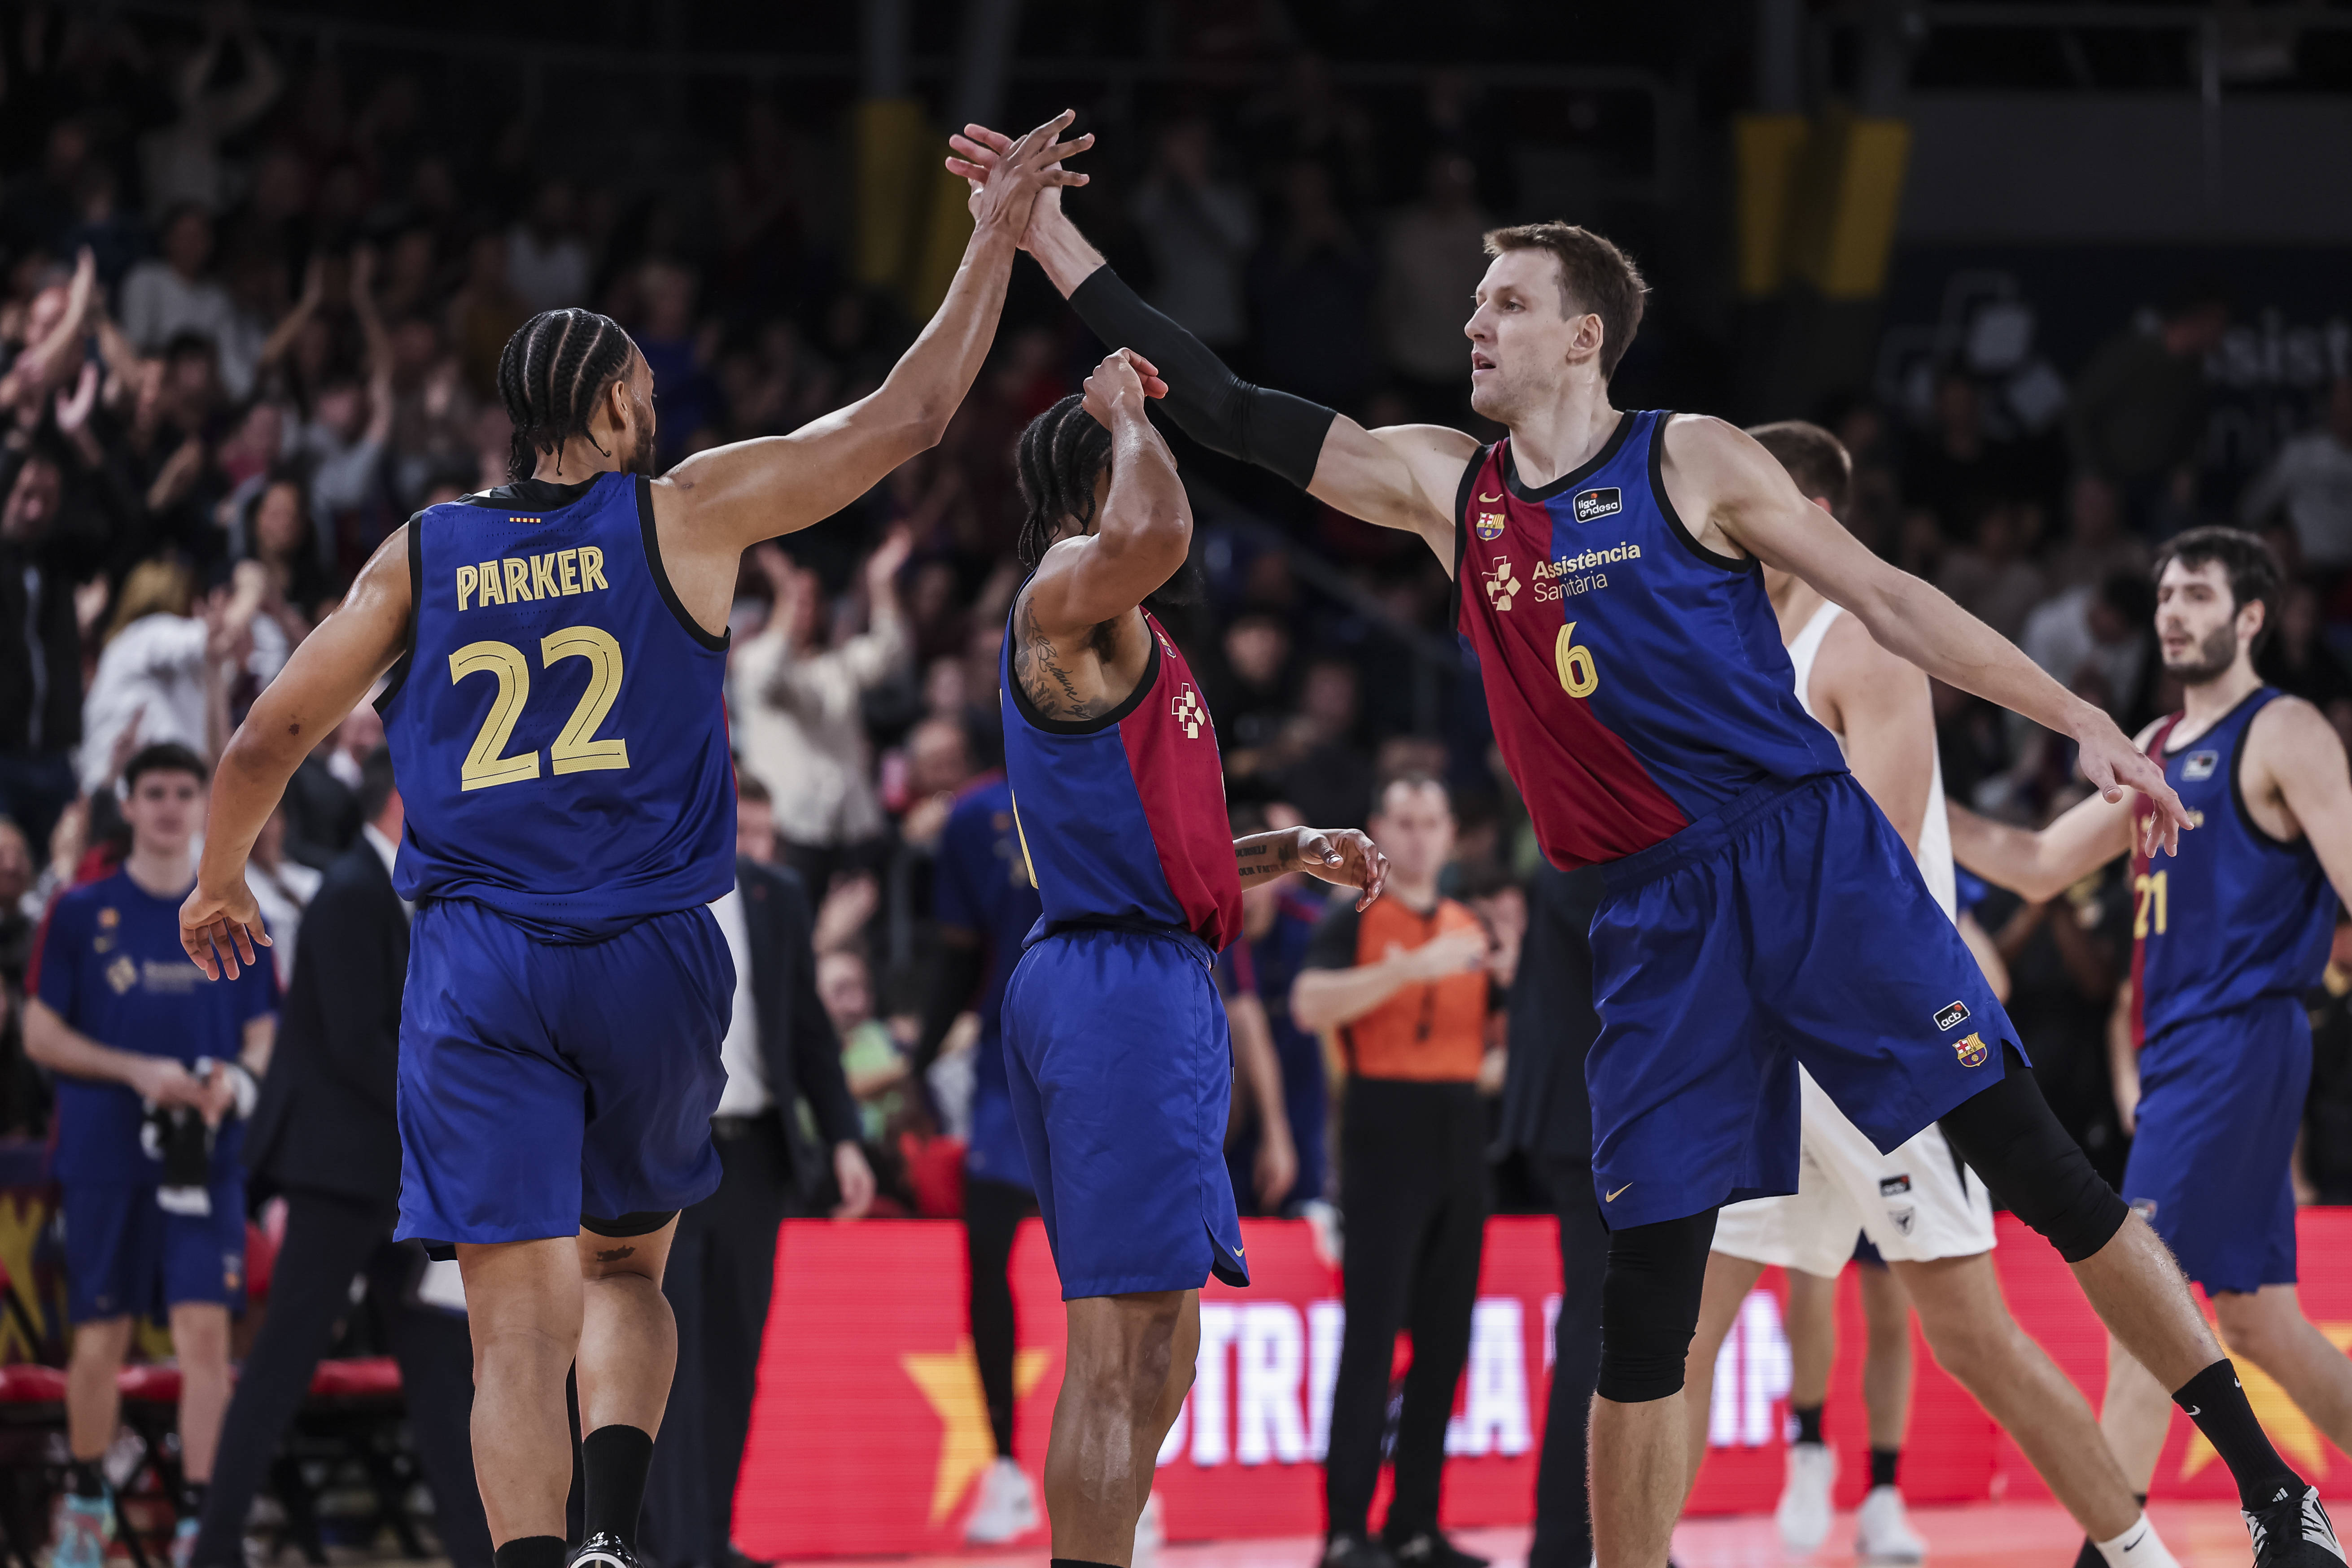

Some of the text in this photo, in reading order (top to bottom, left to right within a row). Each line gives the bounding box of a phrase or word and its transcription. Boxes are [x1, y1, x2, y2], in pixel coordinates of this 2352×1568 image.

[1578, 499, 1596, 509] liga
[1580, 502, 1618, 517] endesa
[1532, 541, 1641, 580] Assistència
[456, 546, 608, 611] PARKER
[1534, 571, 1608, 602] Sanitària
[1555, 621, 1599, 698] 6
[449, 625, 630, 791] 22
[1235, 845, 1267, 857] OURSELF
[1238, 867, 1255, 876] OUR
[2133, 869, 2168, 939] 21
[1941, 1012, 1961, 1026] acb
